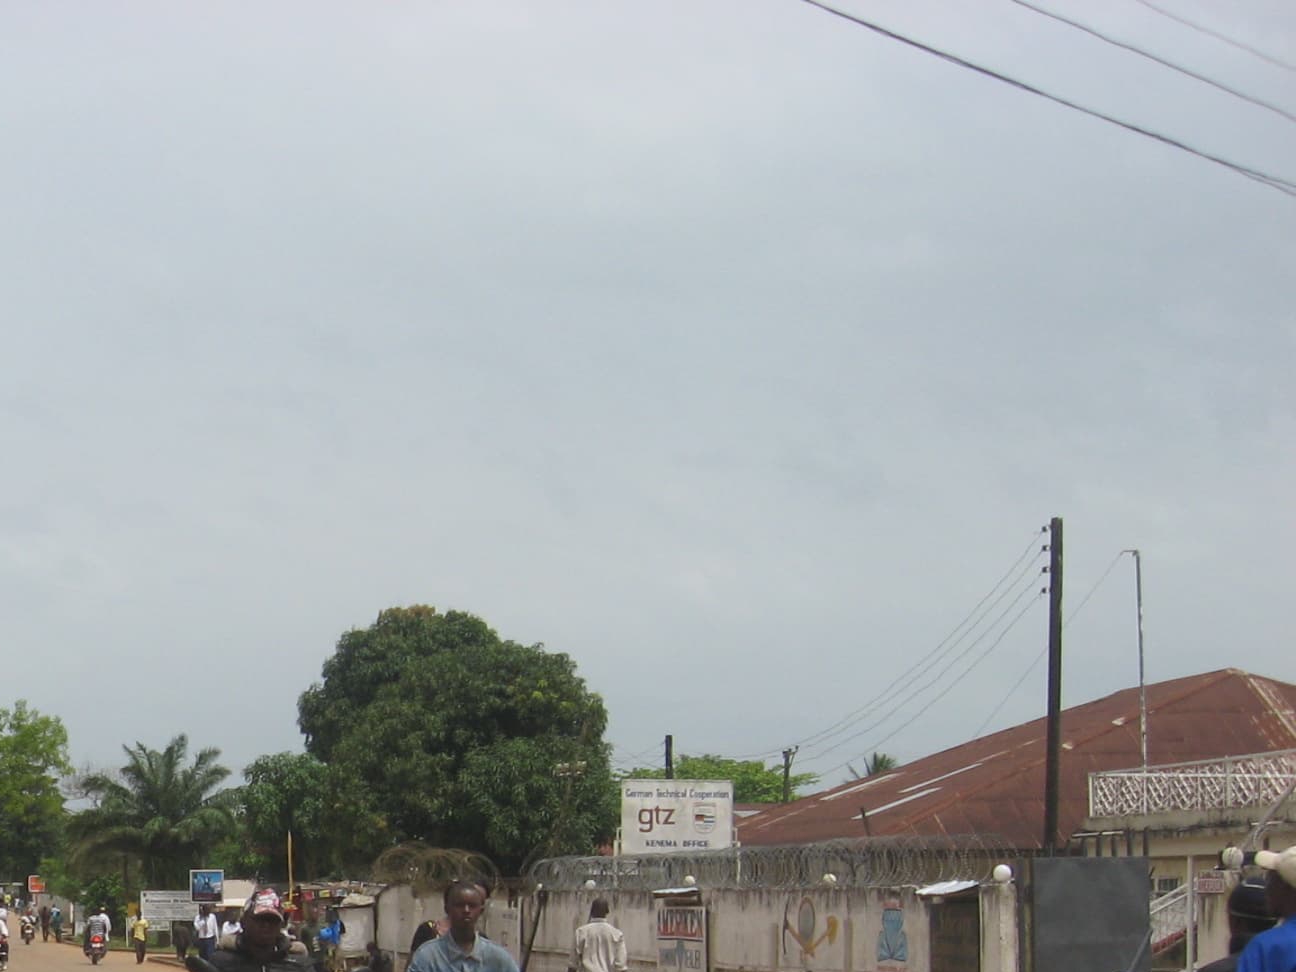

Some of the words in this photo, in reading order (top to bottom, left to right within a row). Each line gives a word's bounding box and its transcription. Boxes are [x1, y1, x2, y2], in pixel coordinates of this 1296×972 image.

[625, 788, 653, 798] German
[656, 788, 687, 798] Technical
[689, 788, 730, 800] Cooperation
[638, 805, 676, 833] gtz
[645, 840, 677, 848] KENEMA
[682, 839, 710, 848] OFFICE
